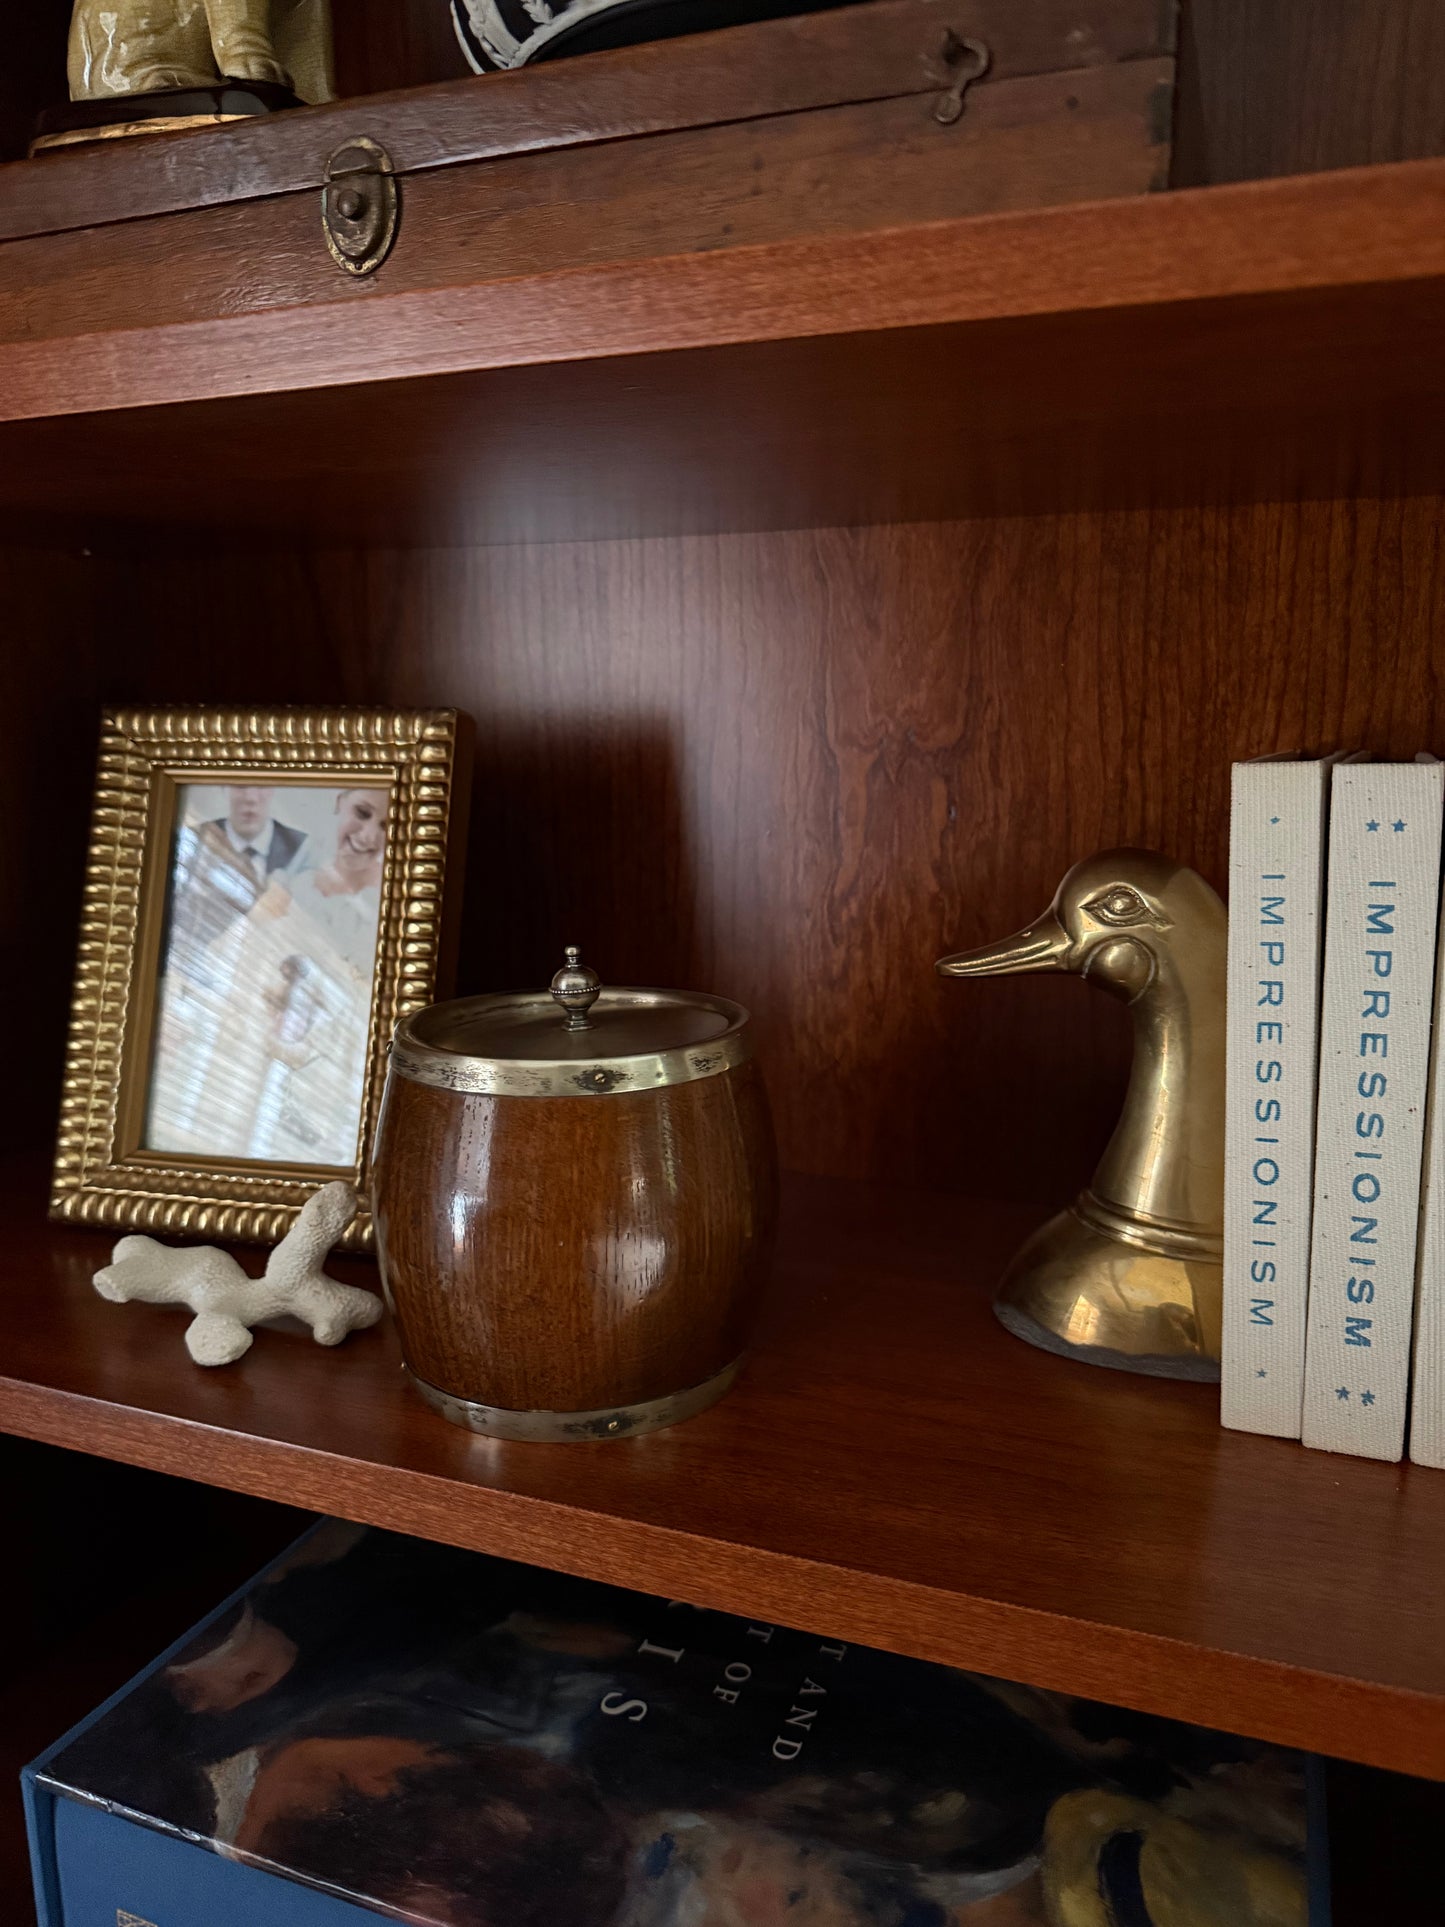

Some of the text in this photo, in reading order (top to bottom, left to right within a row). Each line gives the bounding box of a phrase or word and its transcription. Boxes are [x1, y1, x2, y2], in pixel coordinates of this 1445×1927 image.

[1249, 873, 1287, 1328] IMPRESSIONISM
[1343, 880, 1397, 1349] IMPRESSIONISM
[713, 1661, 752, 1705] OF
[771, 1676, 828, 1761] AND
